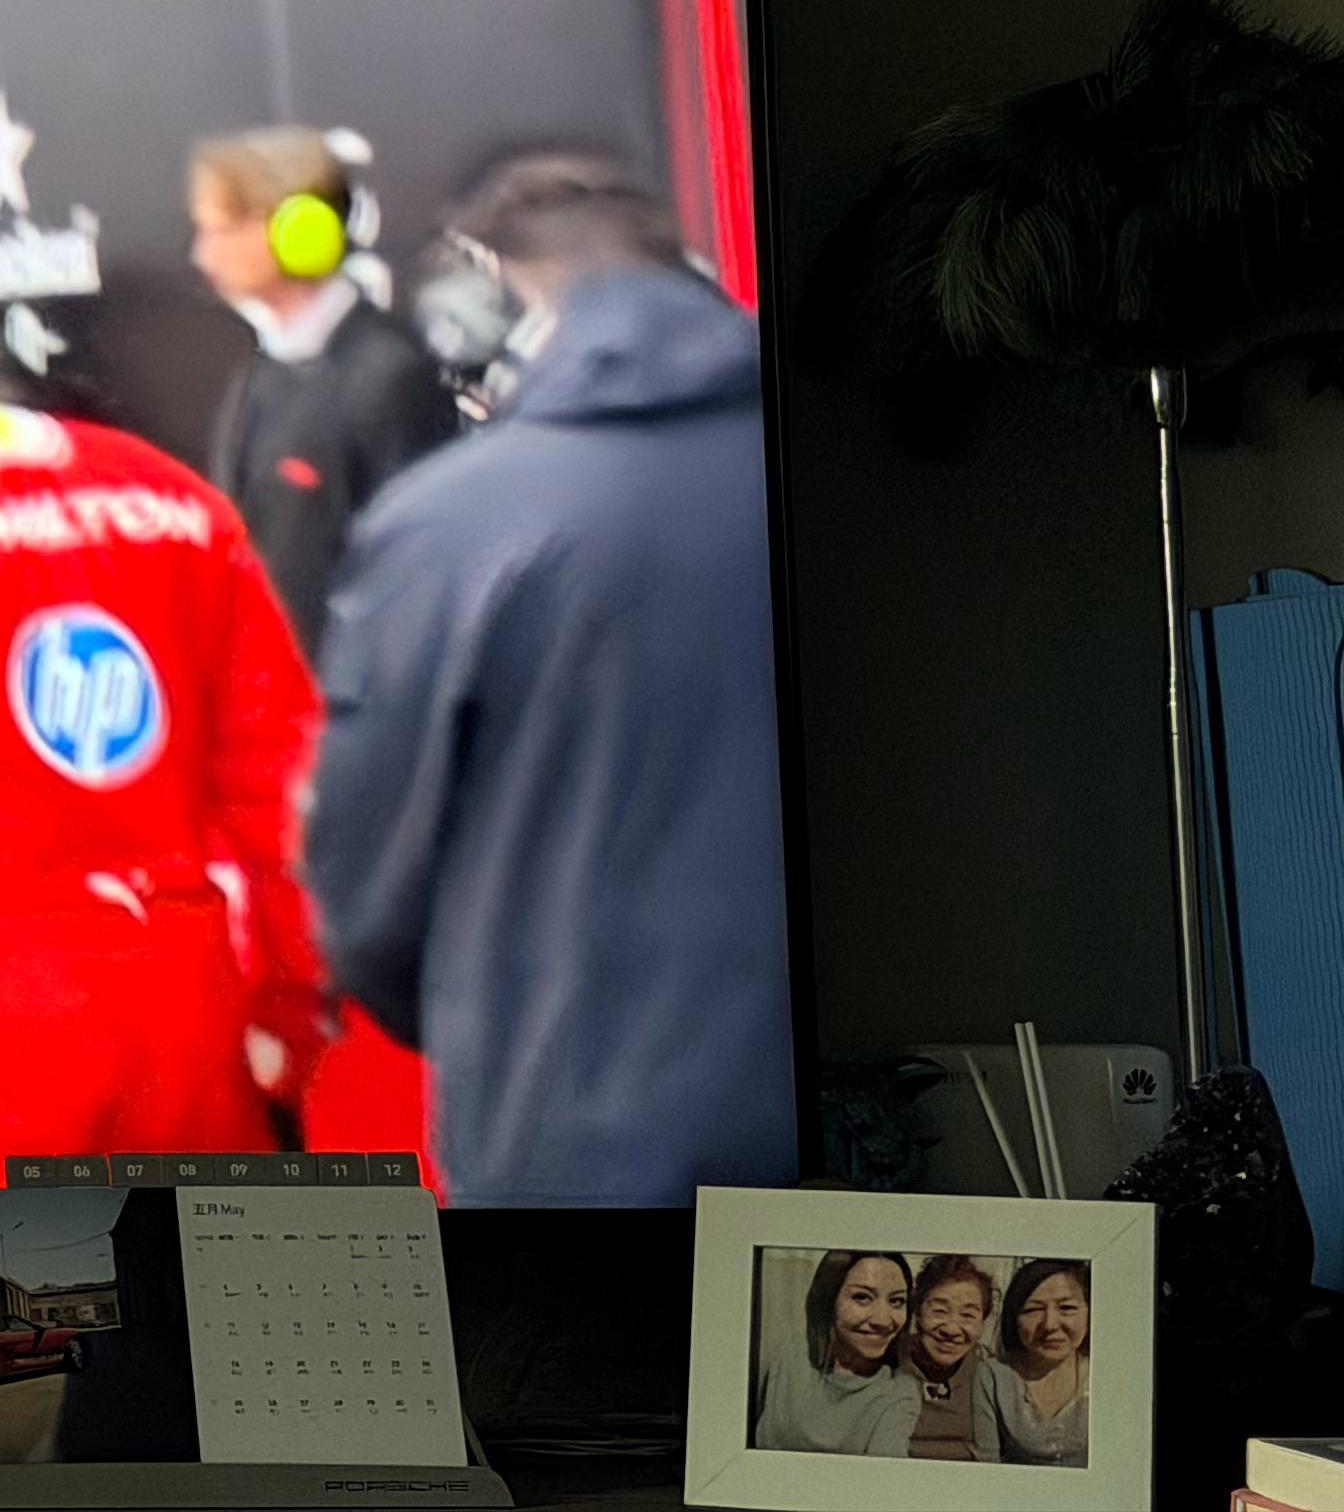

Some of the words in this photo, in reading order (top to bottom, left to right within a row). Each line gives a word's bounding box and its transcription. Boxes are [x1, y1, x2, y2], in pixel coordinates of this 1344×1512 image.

[27, 618, 150, 780] hp
[23, 1165, 41, 1179] 05
[73, 1165, 91, 1178] 06
[127, 1165, 144, 1177] 07
[178, 1164, 197, 1177] 08
[230, 1163, 249, 1177] 09
[282, 1163, 300, 1177] 10
[331, 1164, 349, 1177] 11
[383, 1164, 402, 1177] 12
[220, 1203, 246, 1218] May
[324, 1480, 470, 1492] PORSCHE
